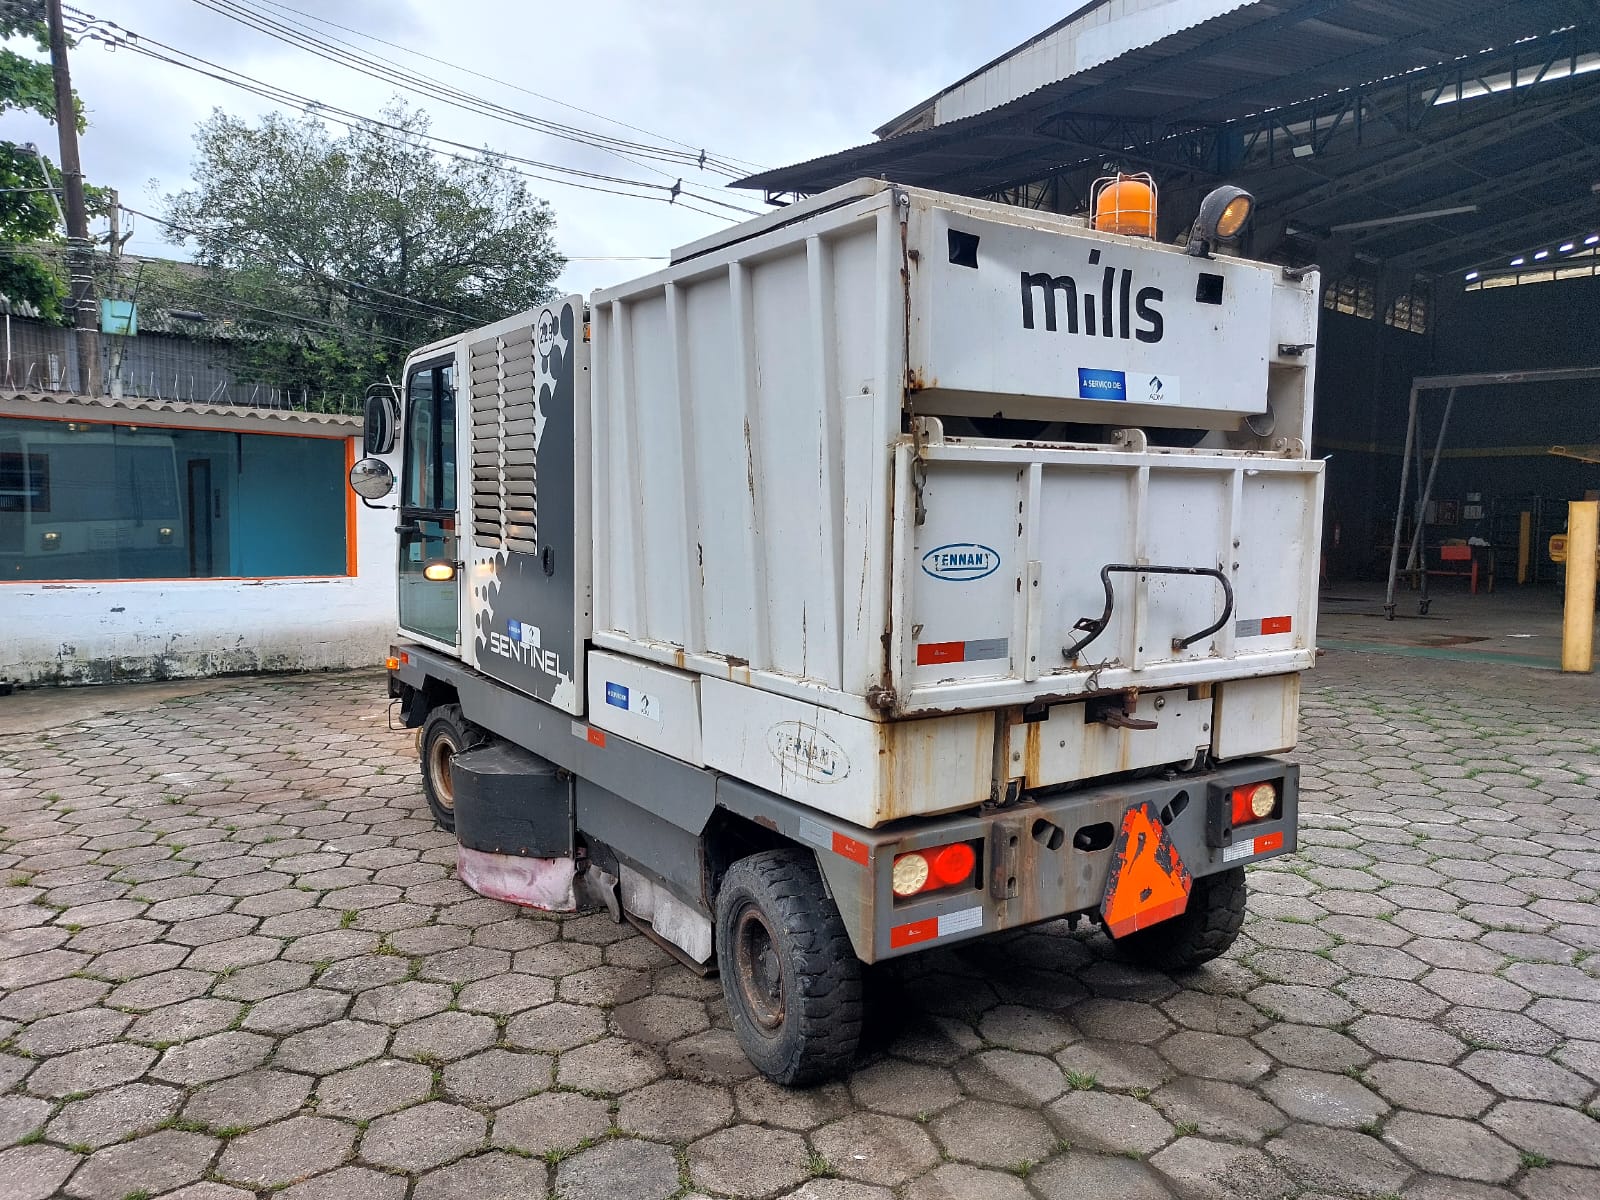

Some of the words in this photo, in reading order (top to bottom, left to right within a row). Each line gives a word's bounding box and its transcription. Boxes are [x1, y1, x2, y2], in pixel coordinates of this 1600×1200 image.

[1021, 249, 1164, 343] mills
[1088, 379, 1112, 391] SERVIÇO
[490, 631, 568, 679] SENTINEL
